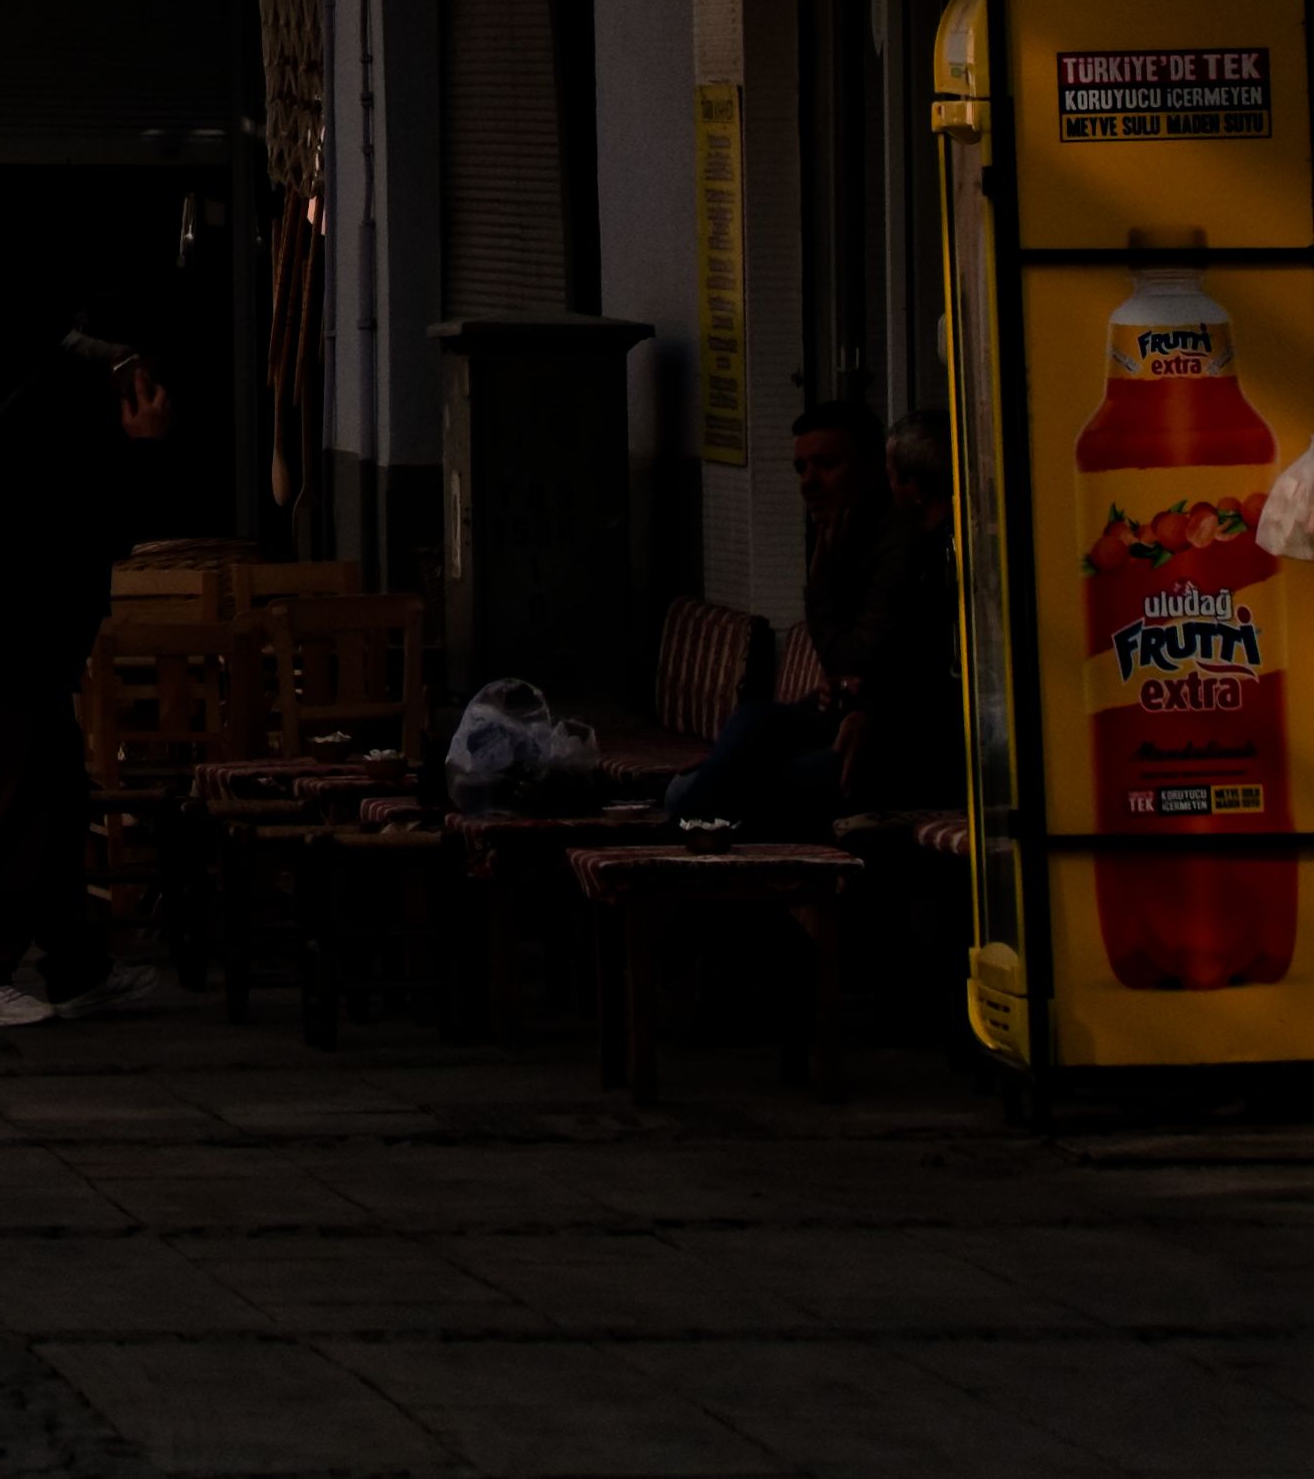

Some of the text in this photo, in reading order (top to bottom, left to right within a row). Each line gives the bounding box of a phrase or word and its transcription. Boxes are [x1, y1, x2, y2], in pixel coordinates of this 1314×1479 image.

[1202, 52, 1262, 80] TEK
[1064, 86, 1263, 111] KORUYUCU İÇERMEYEN
[1066, 113, 1264, 138] MEYVE SULU MADEN SUYU
[1151, 357, 1202, 375] extra
[1143, 586, 1233, 622] uludağ
[1139, 671, 1243, 712] extra
[1129, 797, 1155, 813] TEK
